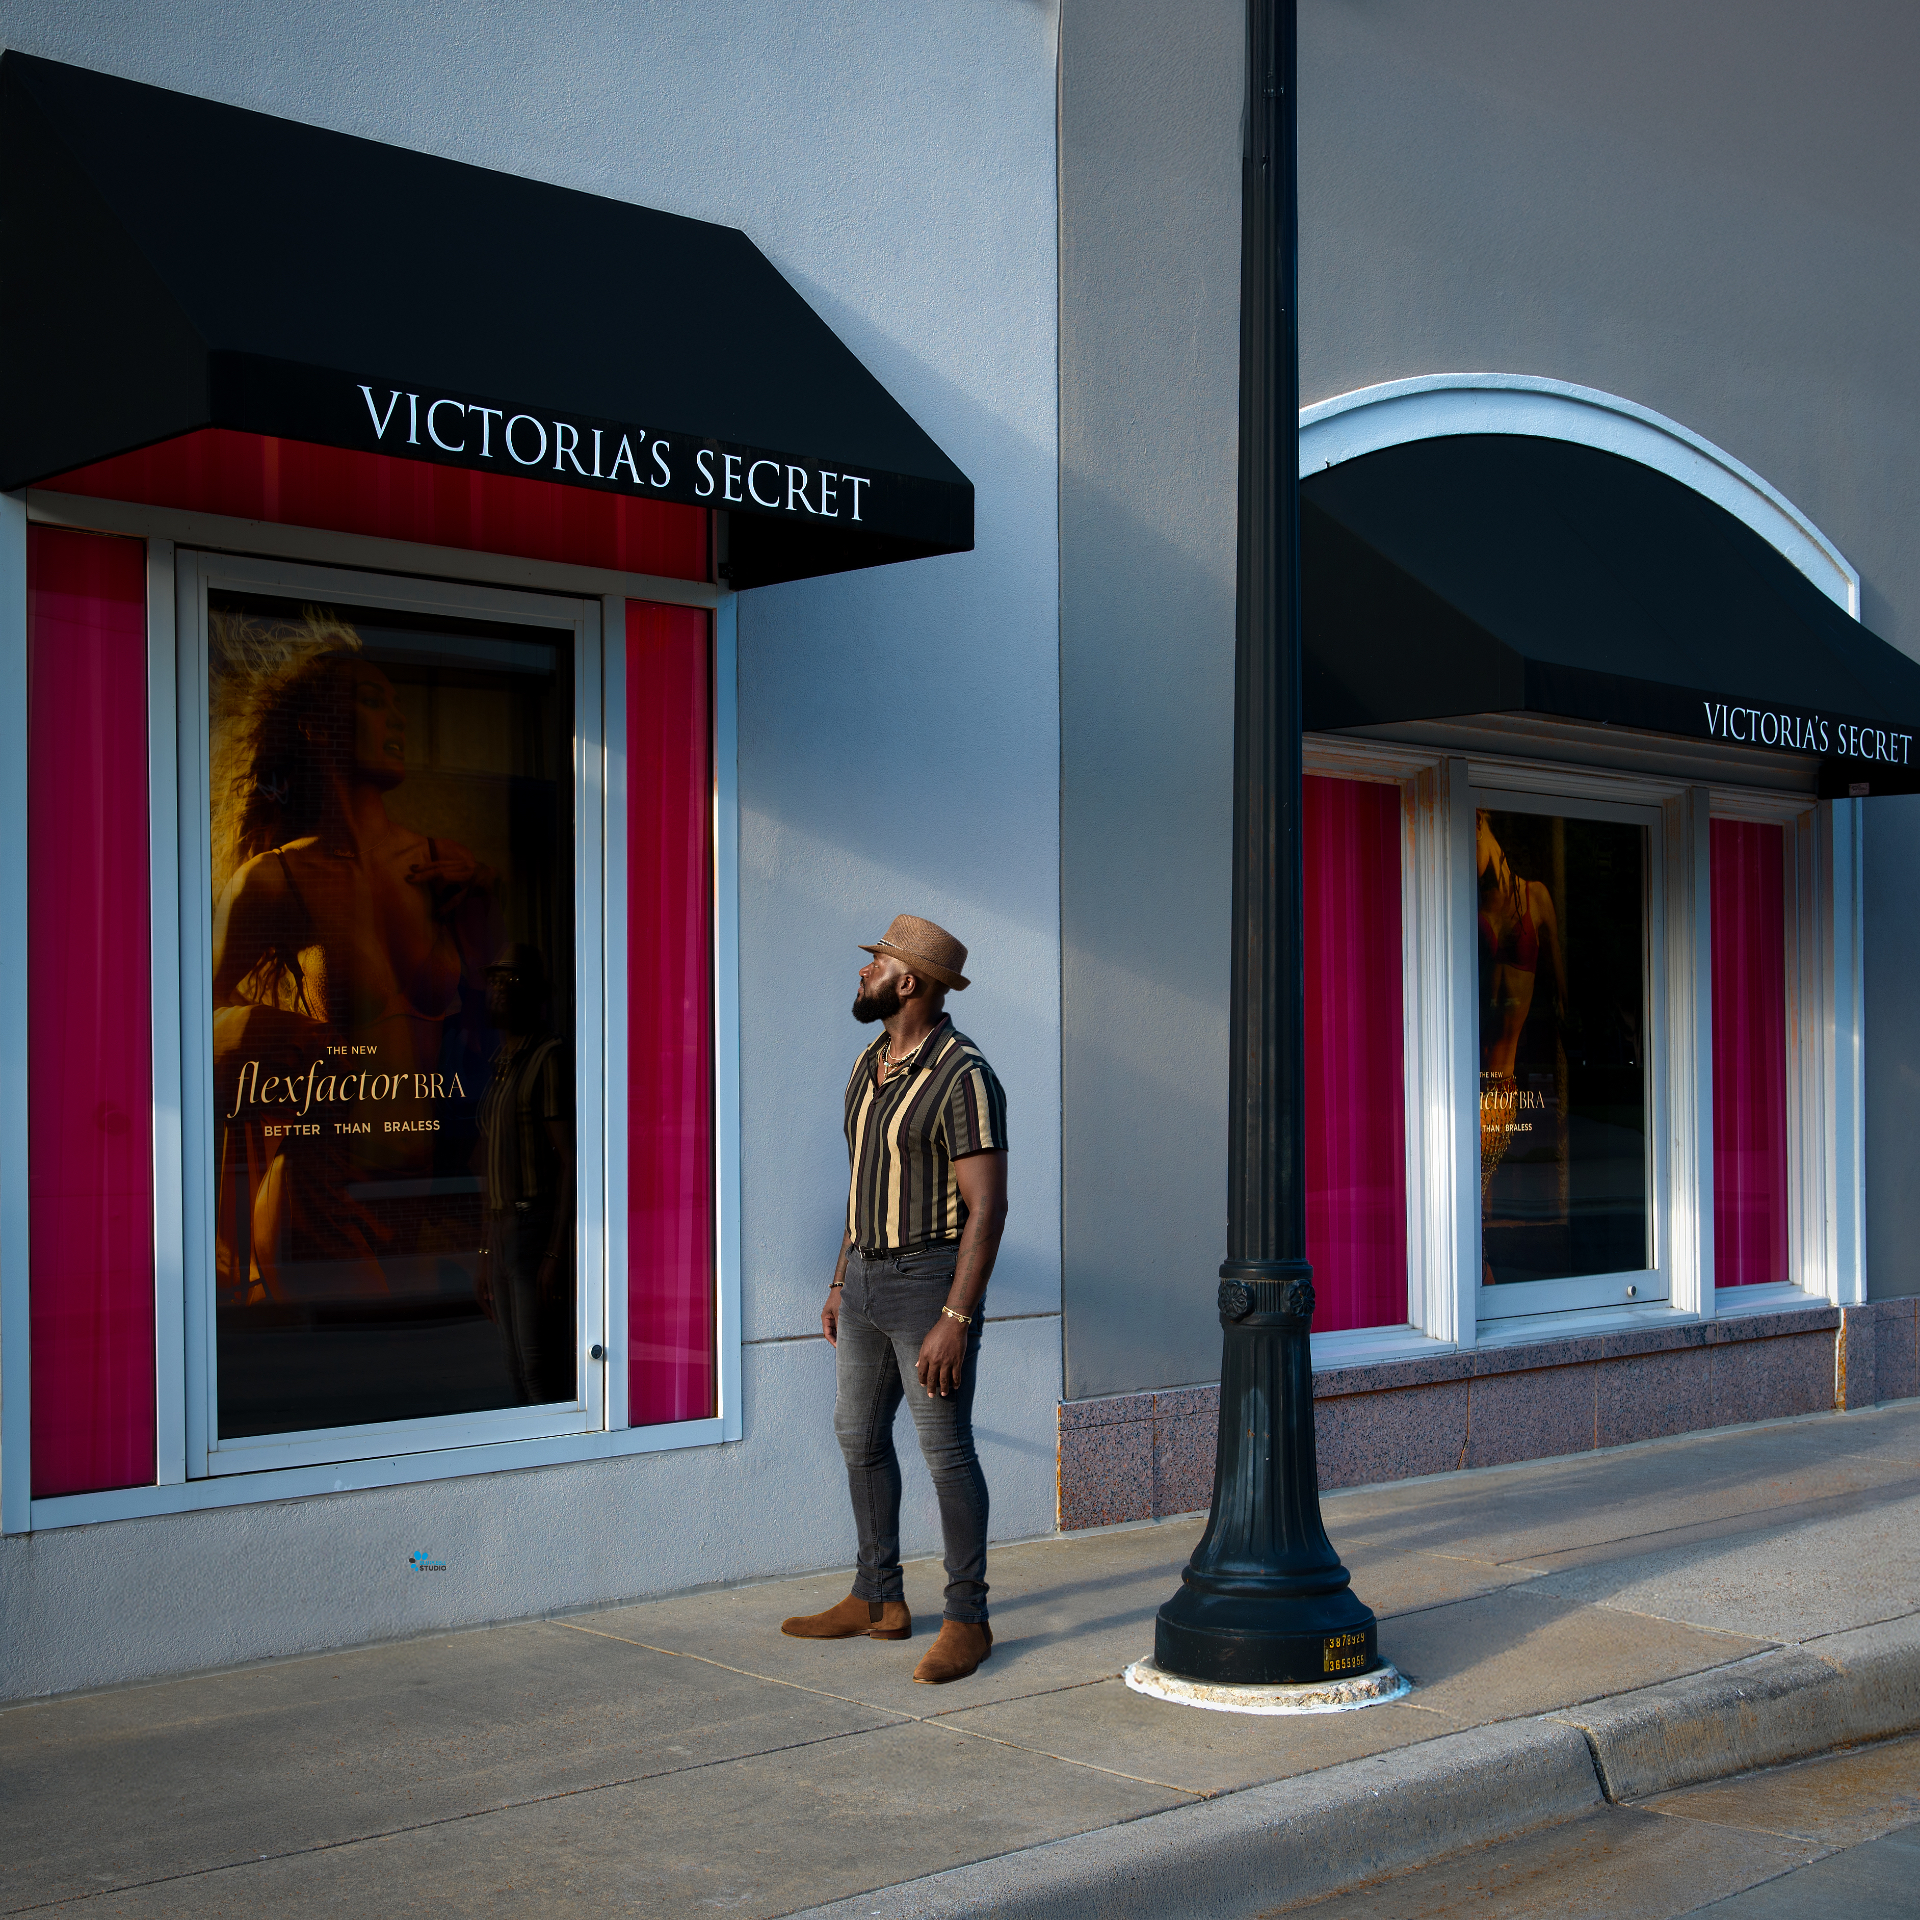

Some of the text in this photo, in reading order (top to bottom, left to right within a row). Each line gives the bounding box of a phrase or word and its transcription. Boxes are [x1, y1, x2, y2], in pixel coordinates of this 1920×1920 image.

[356, 384, 871, 522] VICTORIA'S SECRET
[1703, 701, 1913, 765] VICTORIA'S SECRET
[326, 1045, 378, 1055] THE NEW
[226, 1059, 466, 1119] flexfactor BRA
[1519, 1091, 1545, 1109] BRA
[264, 1120, 440, 1137] BETTER THAN BRALESS
[1482, 1123, 1533, 1133] THAN BRALESS
